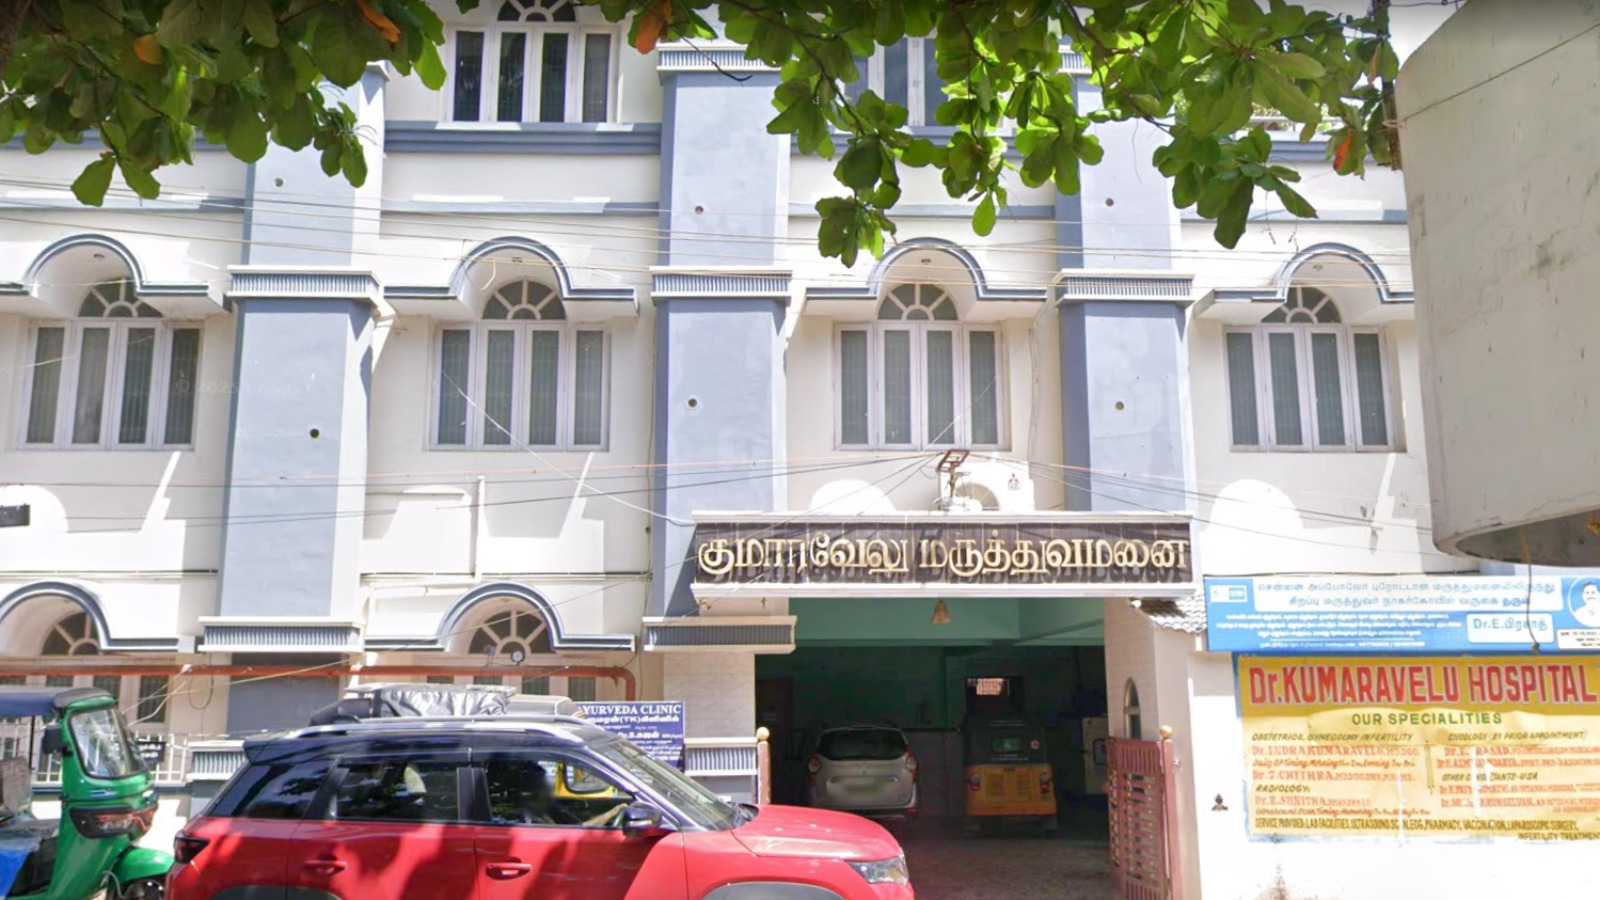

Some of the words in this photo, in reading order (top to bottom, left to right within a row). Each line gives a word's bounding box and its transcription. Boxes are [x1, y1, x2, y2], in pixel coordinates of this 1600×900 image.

[698, 531, 909, 575] குமாரவேலு
[918, 530, 1189, 578] மருத்துவமனை
[1249, 664, 1461, 705] Dr.KUMARAVELU
[1469, 664, 1598, 704] HOSPITAL
[640, 704, 682, 715] CLINIC
[1351, 713, 1383, 726] OUR
[1388, 712, 1503, 726] SPECIALITIES
